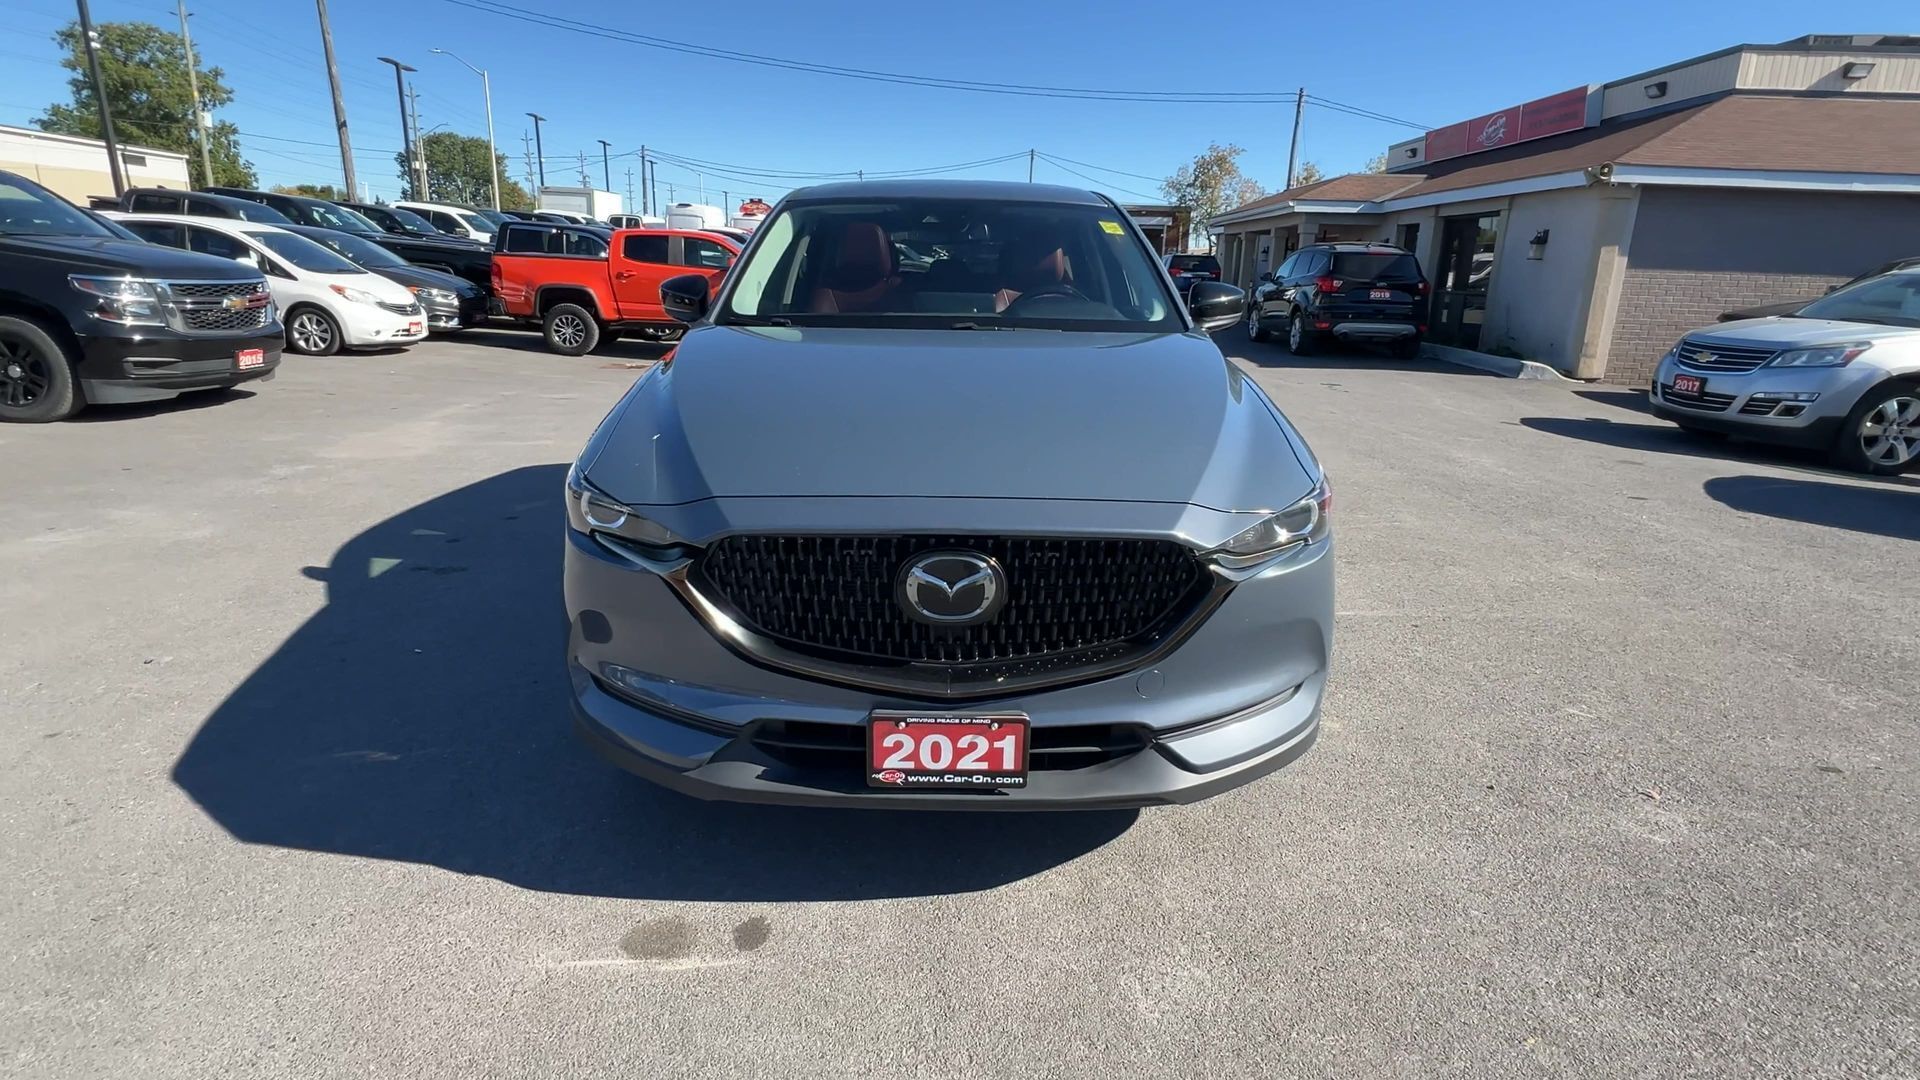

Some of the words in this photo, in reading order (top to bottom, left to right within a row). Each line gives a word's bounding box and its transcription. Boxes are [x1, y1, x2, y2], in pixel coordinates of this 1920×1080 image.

[239, 353, 263, 366] 2015
[1674, 379, 1700, 391] 2017
[882, 733, 1016, 770] 2021
[907, 774, 1023, 784] www.Car-On.com
